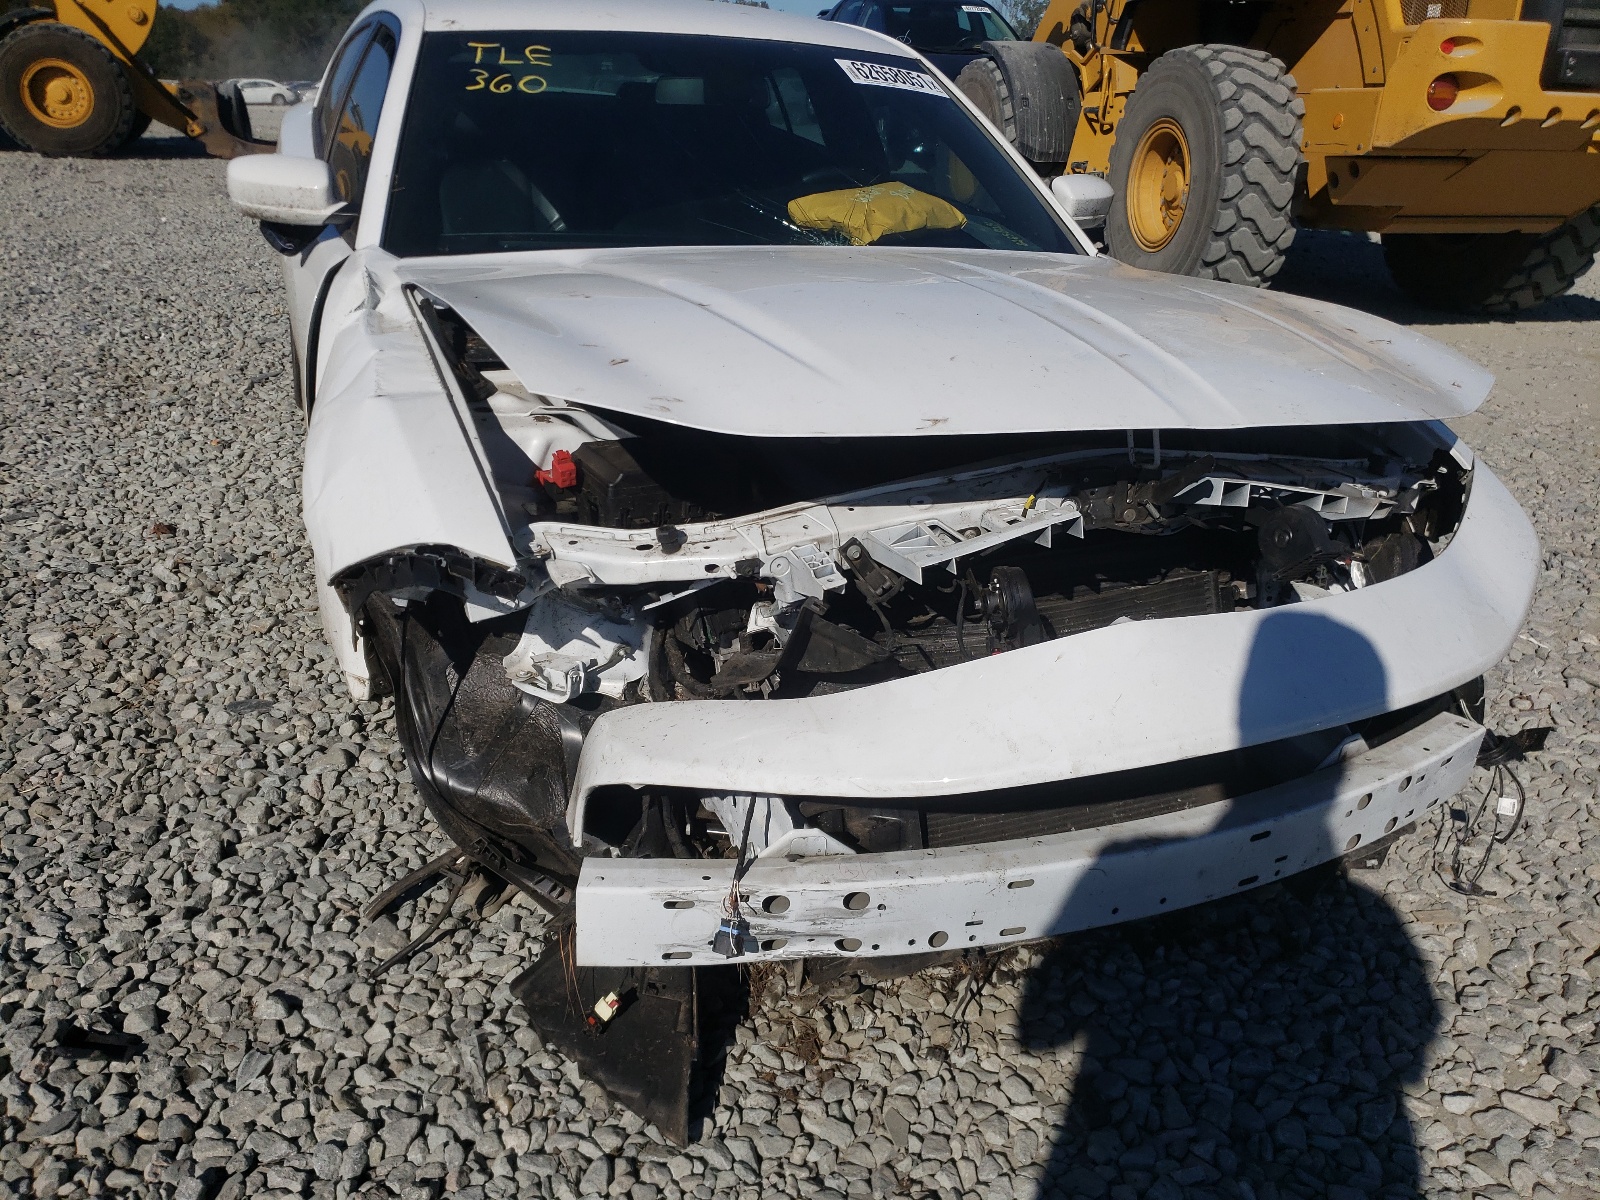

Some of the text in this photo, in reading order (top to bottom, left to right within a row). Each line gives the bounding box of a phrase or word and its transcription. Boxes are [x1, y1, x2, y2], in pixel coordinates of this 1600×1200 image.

[467, 42, 552, 67] TLE
[465, 68, 547, 94] 360
[850, 61, 934, 91] 62658051
